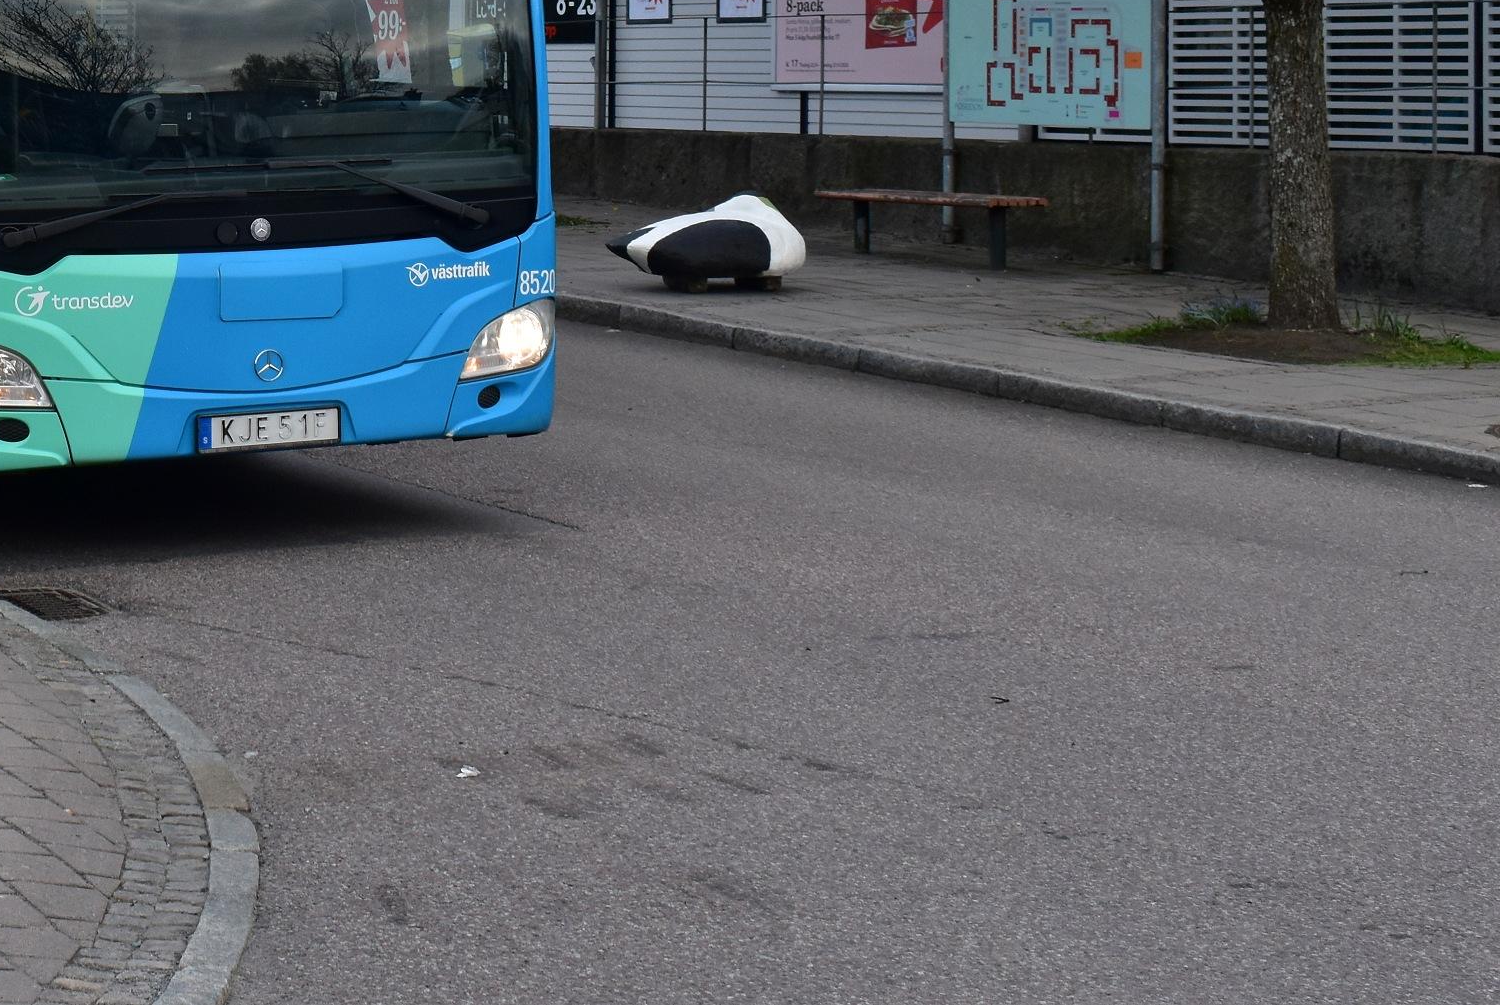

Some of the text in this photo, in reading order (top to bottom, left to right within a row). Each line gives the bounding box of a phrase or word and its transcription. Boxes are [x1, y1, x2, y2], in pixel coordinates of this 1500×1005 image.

[378, 10, 406, 40] 99:-
[431, 261, 491, 280] västtrafik
[520, 269, 556, 295] 8520
[51, 291, 134, 310] transdev
[221, 417, 268, 444] KJE
